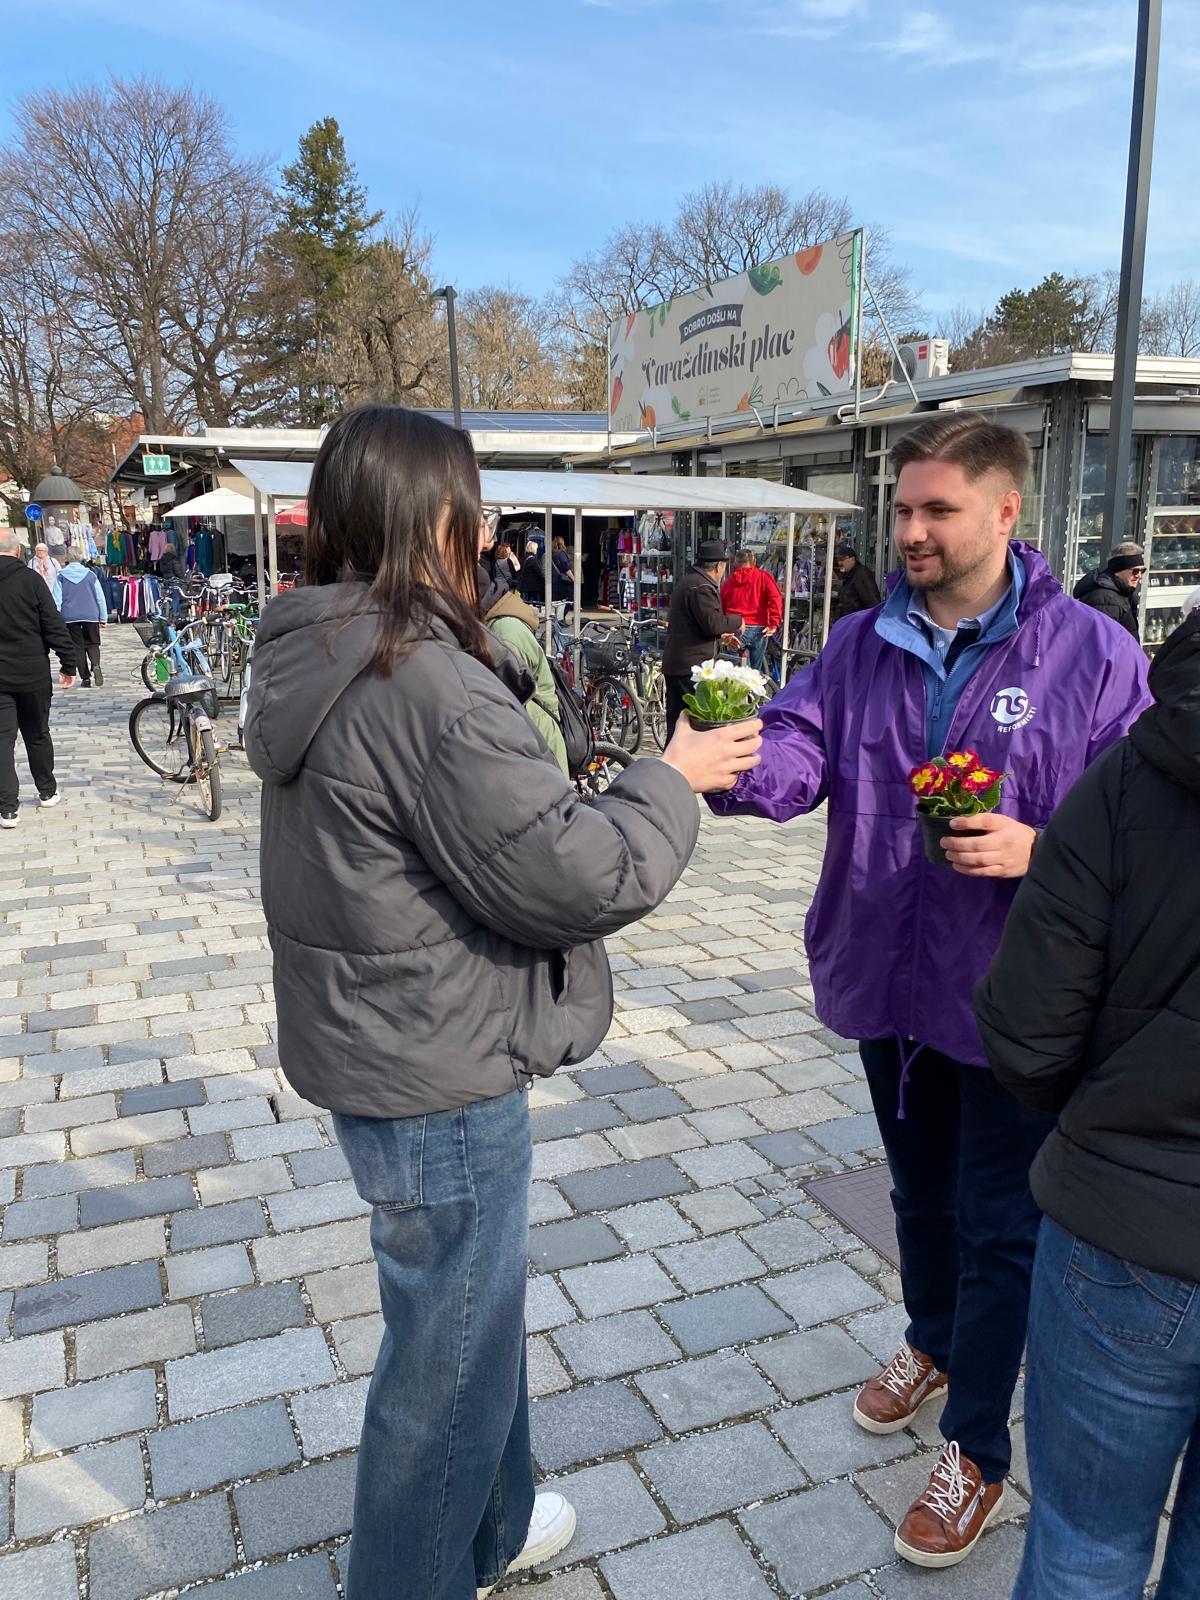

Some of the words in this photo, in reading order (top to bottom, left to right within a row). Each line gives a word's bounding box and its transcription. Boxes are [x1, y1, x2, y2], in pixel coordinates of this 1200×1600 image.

[683, 316, 706, 336] DOBRO
[706, 309, 726, 325] DOŠLI
[727, 309, 737, 321] NA
[641, 330, 747, 389] Varaždinski
[749, 324, 795, 373] plac
[997, 706, 1037, 733] REFORMISTI
